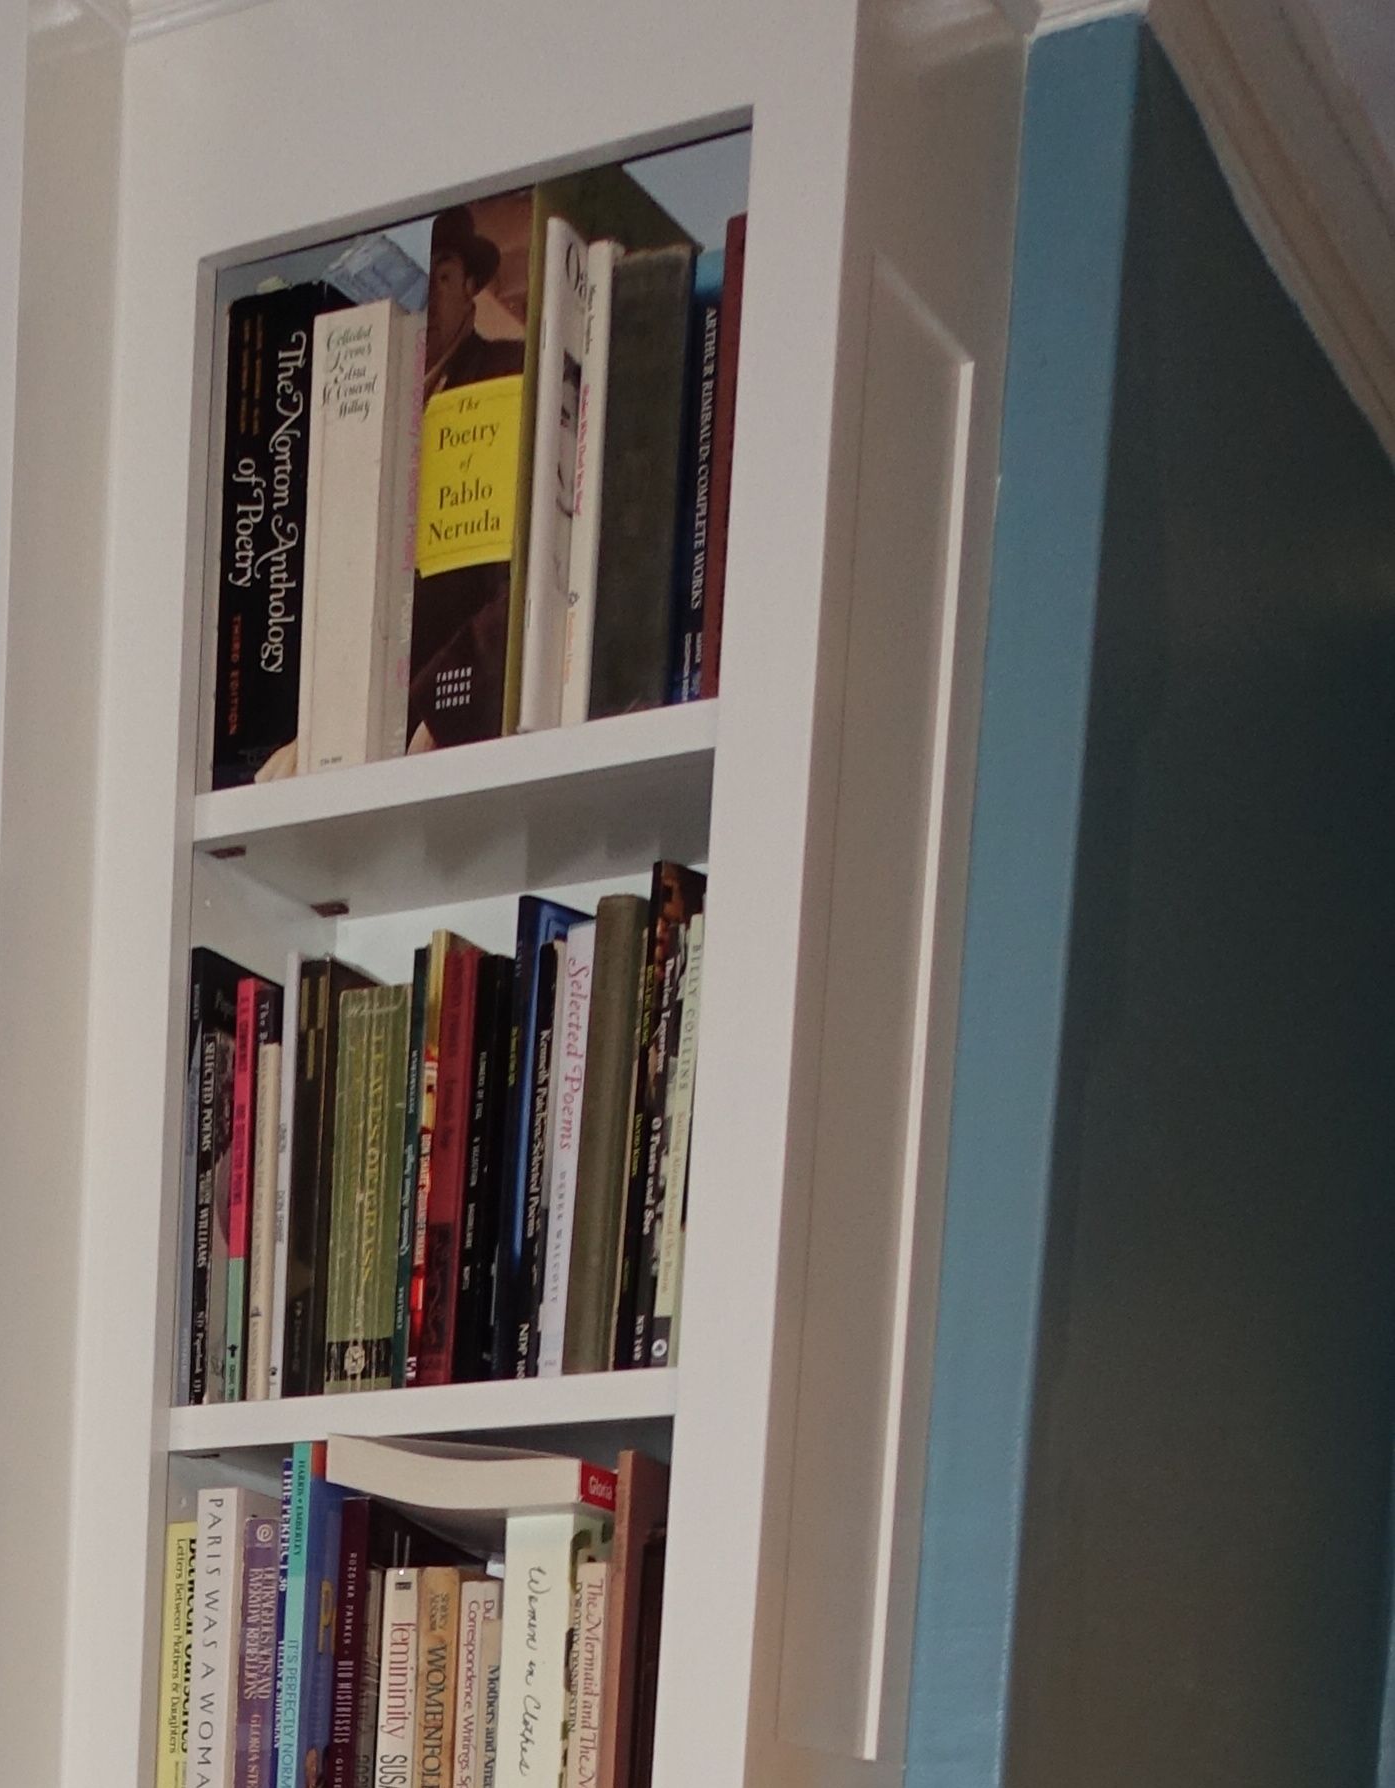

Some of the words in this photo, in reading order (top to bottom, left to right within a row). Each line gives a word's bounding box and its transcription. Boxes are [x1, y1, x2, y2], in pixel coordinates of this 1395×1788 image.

[276, 330, 307, 394] The
[269, 396, 302, 521] Norton
[438, 422, 499, 455] Poetry
[237, 457, 261, 485] of
[439, 484, 493, 511] Pablo
[228, 488, 264, 589] Poetry
[428, 517, 502, 545] Neruda
[261, 526, 299, 673] Anthology
[206, 1497, 226, 1582] PARIS
[204, 1589, 220, 1650] WAS
[525, 1566, 552, 1657] Women
[202, 1661, 213, 1684] A
[380, 1623, 408, 1740] femininity
[525, 1661, 540, 1691] in
[518, 1693, 547, 1777] Clothes
